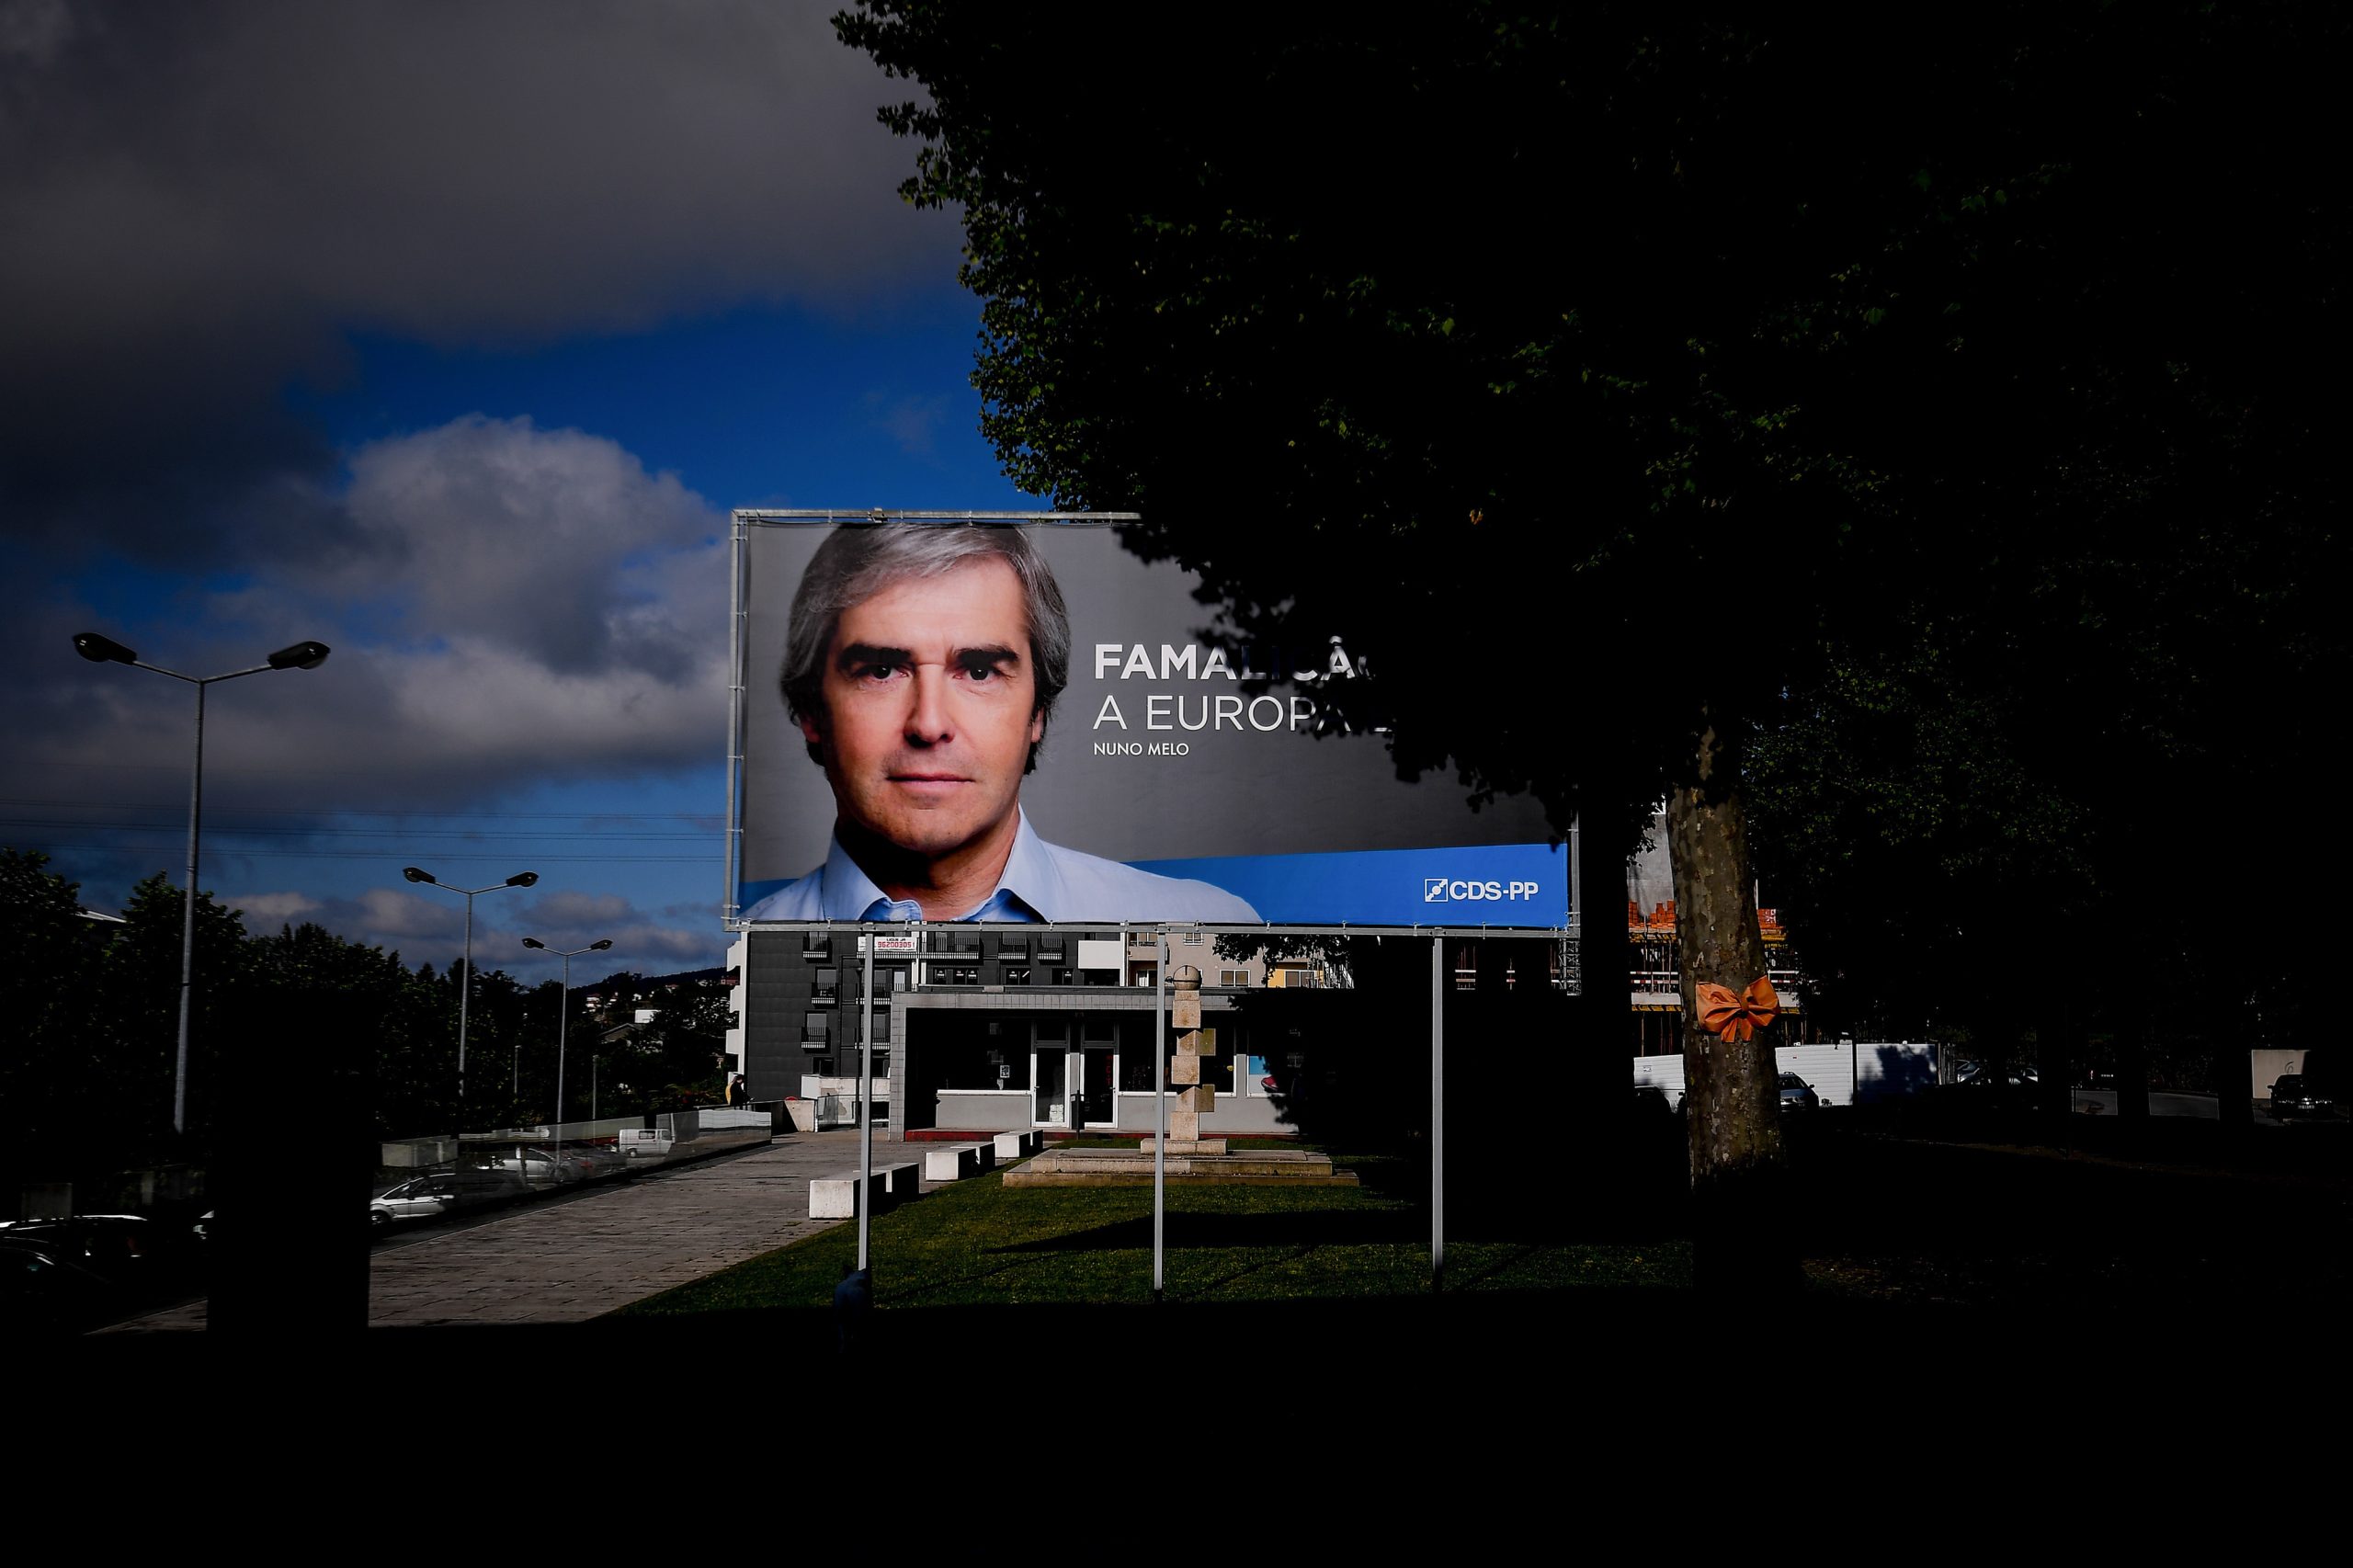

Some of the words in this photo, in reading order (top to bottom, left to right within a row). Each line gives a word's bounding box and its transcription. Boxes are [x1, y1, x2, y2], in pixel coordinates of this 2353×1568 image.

[1093, 695, 1127, 730] A
[1094, 743, 1142, 756] NUNO
[1148, 743, 1189, 756] MELO
[1449, 881, 1539, 901] CDS-PP
